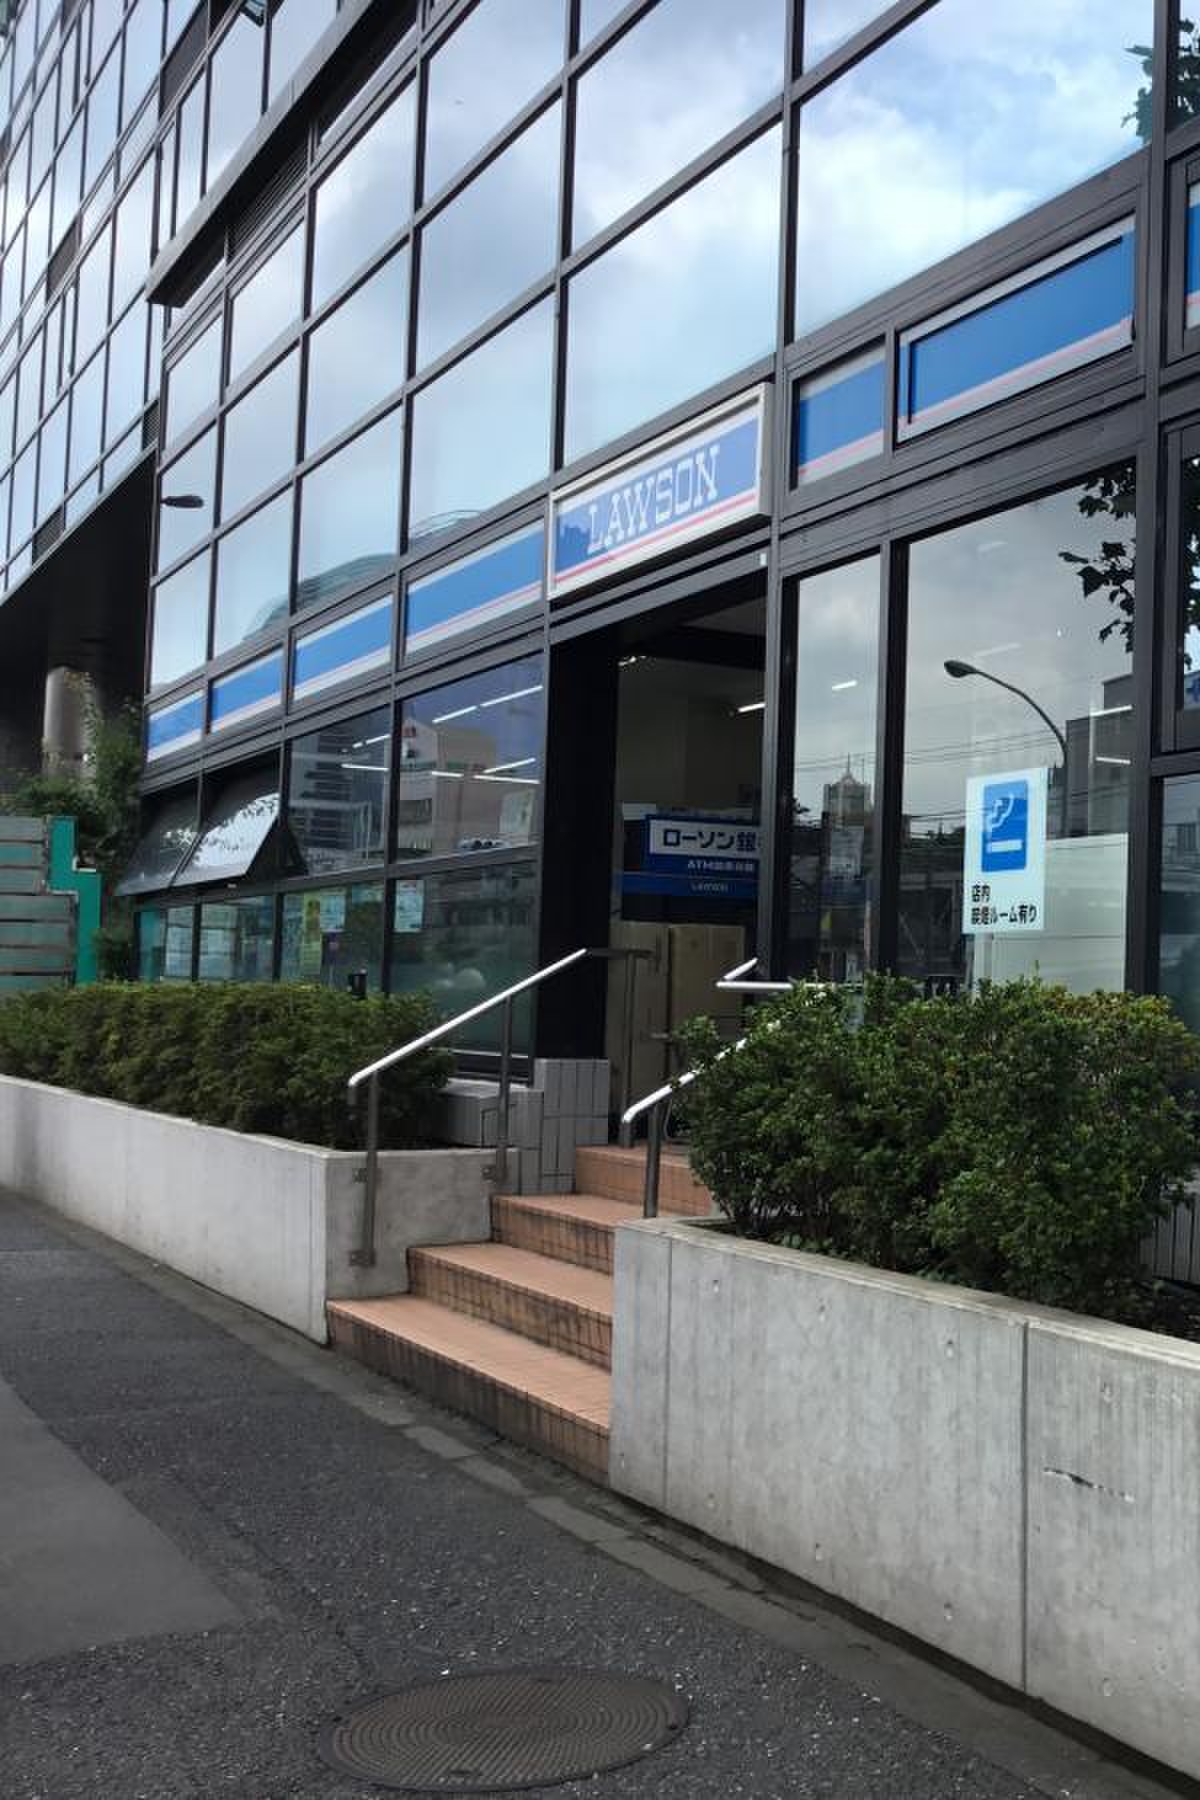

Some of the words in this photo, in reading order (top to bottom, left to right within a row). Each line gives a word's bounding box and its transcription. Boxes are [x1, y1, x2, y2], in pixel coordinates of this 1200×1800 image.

[587, 444, 721, 554] LAWSON
[664, 829, 761, 851] ローソン銀
[971, 884, 991, 902] 店内
